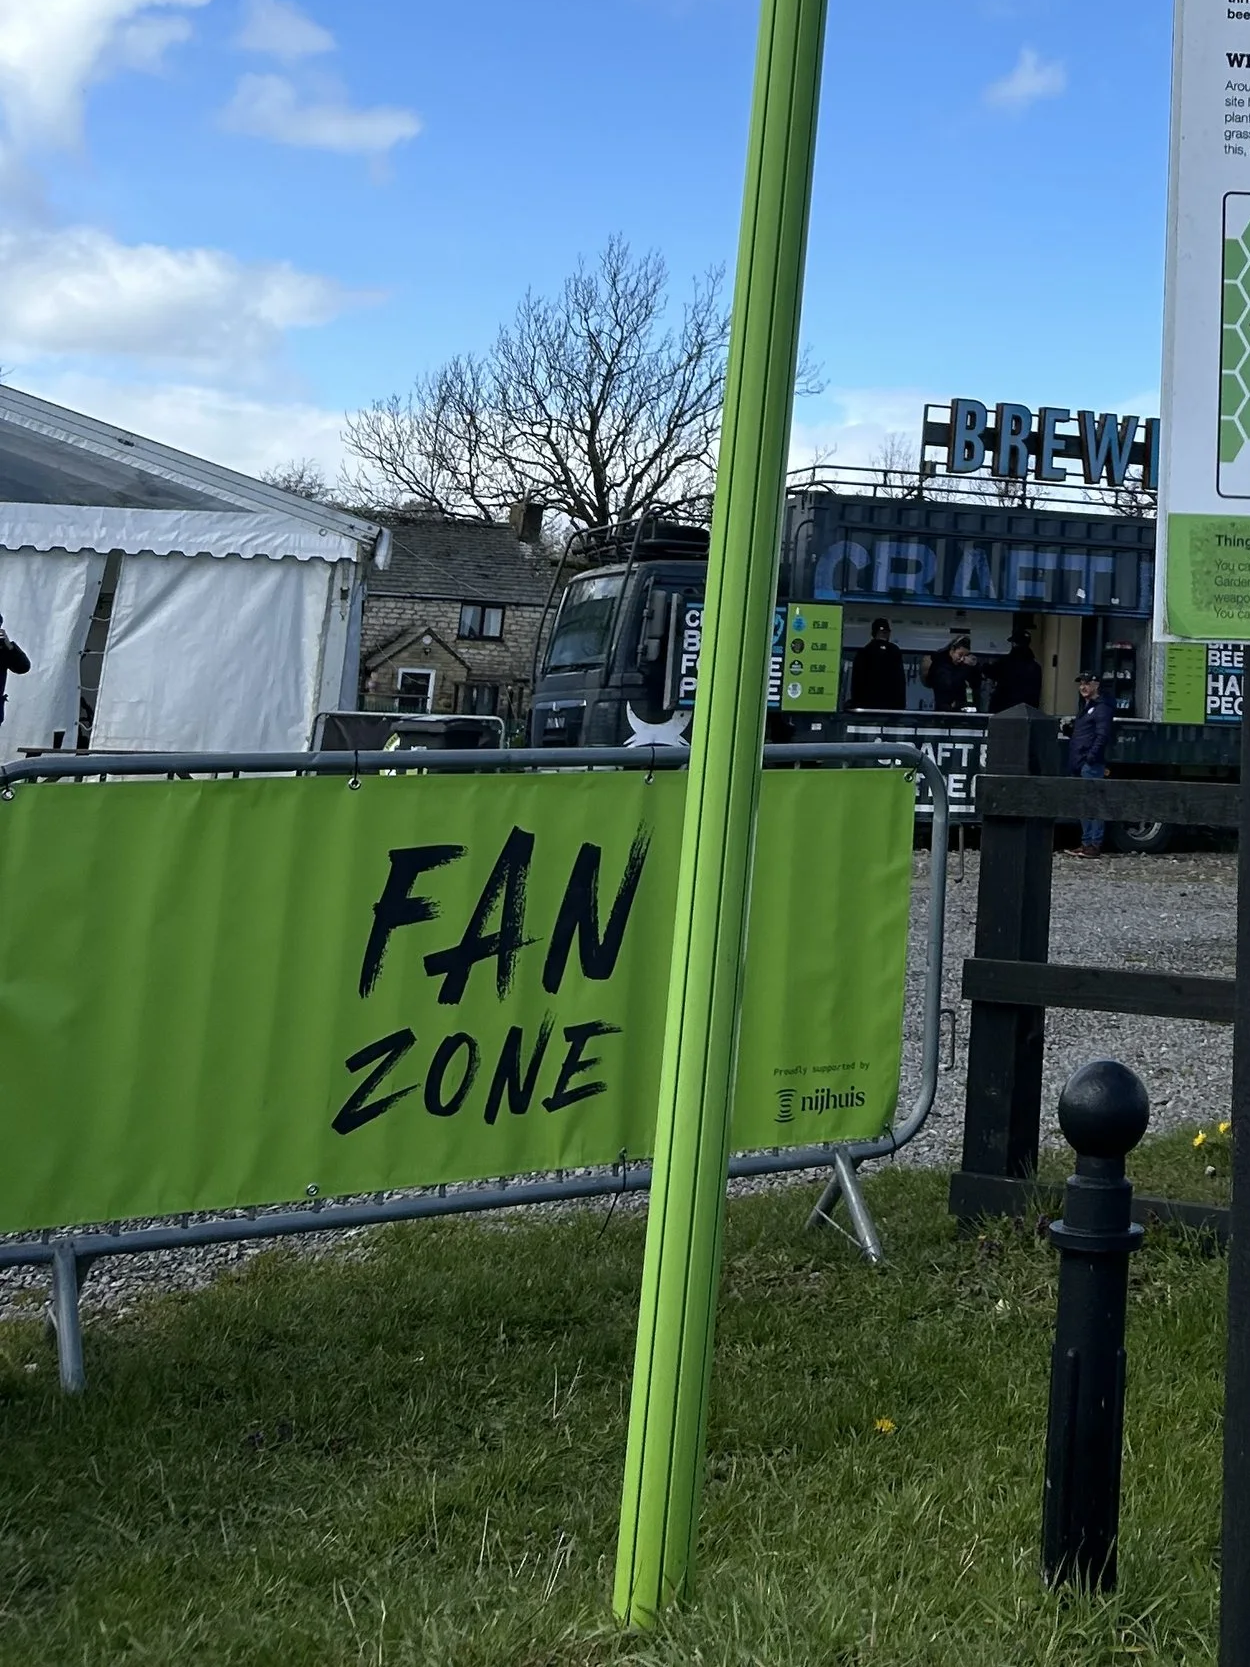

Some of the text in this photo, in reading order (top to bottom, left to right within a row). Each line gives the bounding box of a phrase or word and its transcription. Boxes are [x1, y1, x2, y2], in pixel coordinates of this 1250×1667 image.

[1223, 143, 1247, 157] this,
[813, 540, 1114, 606] CRAFT
[1213, 605, 1234, 619] You
[357, 818, 654, 1005] FAN
[330, 1011, 622, 1136] ZONE
[812, 1062, 856, 1073] supported
[859, 1062, 870, 1070] by
[801, 1085, 866, 1115] nijhuis
